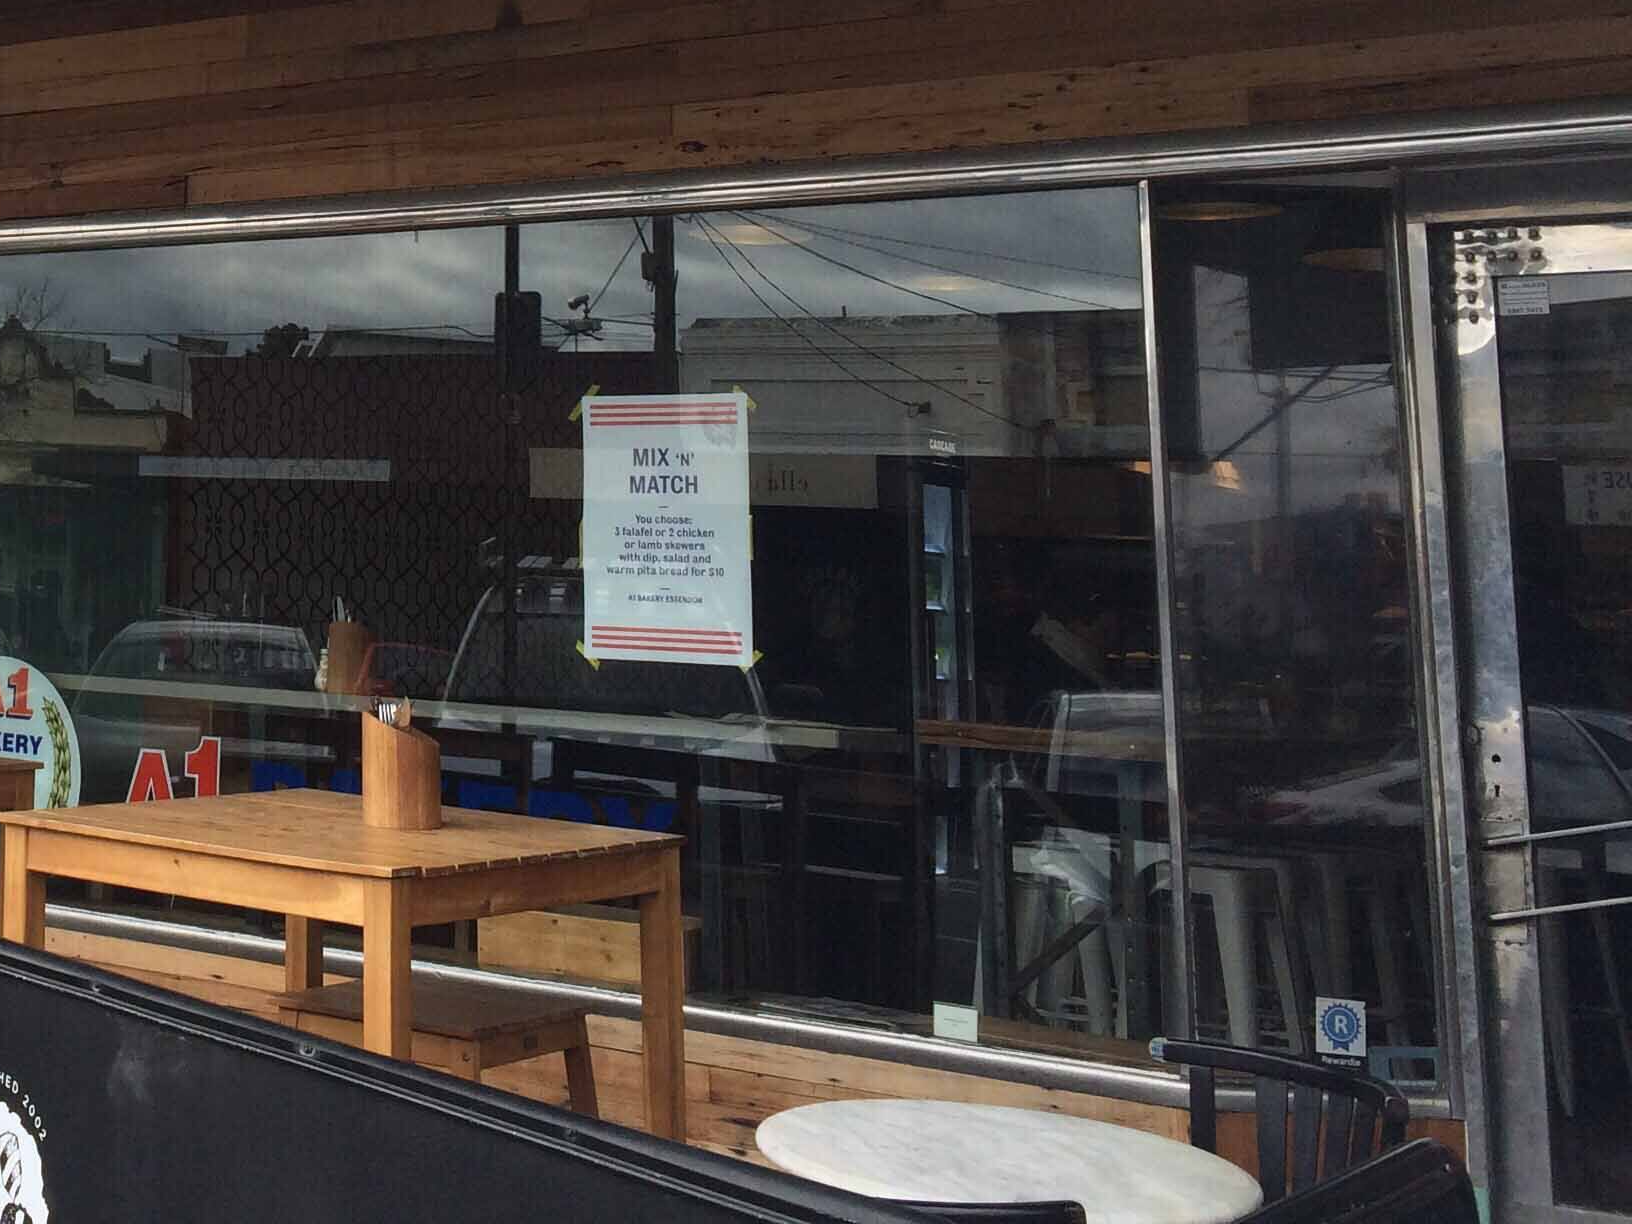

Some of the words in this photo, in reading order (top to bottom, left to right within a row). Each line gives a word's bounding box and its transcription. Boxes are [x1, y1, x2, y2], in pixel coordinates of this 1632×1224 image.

[632, 447, 670, 467] MIX
[629, 474, 699, 494] MATCH
[635, 514, 653, 524] You
[622, 526, 653, 537] falafel
[655, 528, 667, 537] or
[668, 527, 675, 537] 2
[676, 527, 715, 538] chicken
[624, 541, 635, 549] or
[638, 540, 663, 550] lamb
[664, 541, 705, 551] skewers
[619, 552, 641, 562] with
[663, 553, 690, 563] salad
[692, 554, 712, 564] and
[606, 566, 635, 575] warm
[637, 566, 657, 576] pita
[659, 566, 688, 576] bread
[690, 567, 706, 577] for
[126, 735, 223, 804] A1
[1334, 1014, 1348, 1035] R
[22, 1094, 47, 1142] 2002
